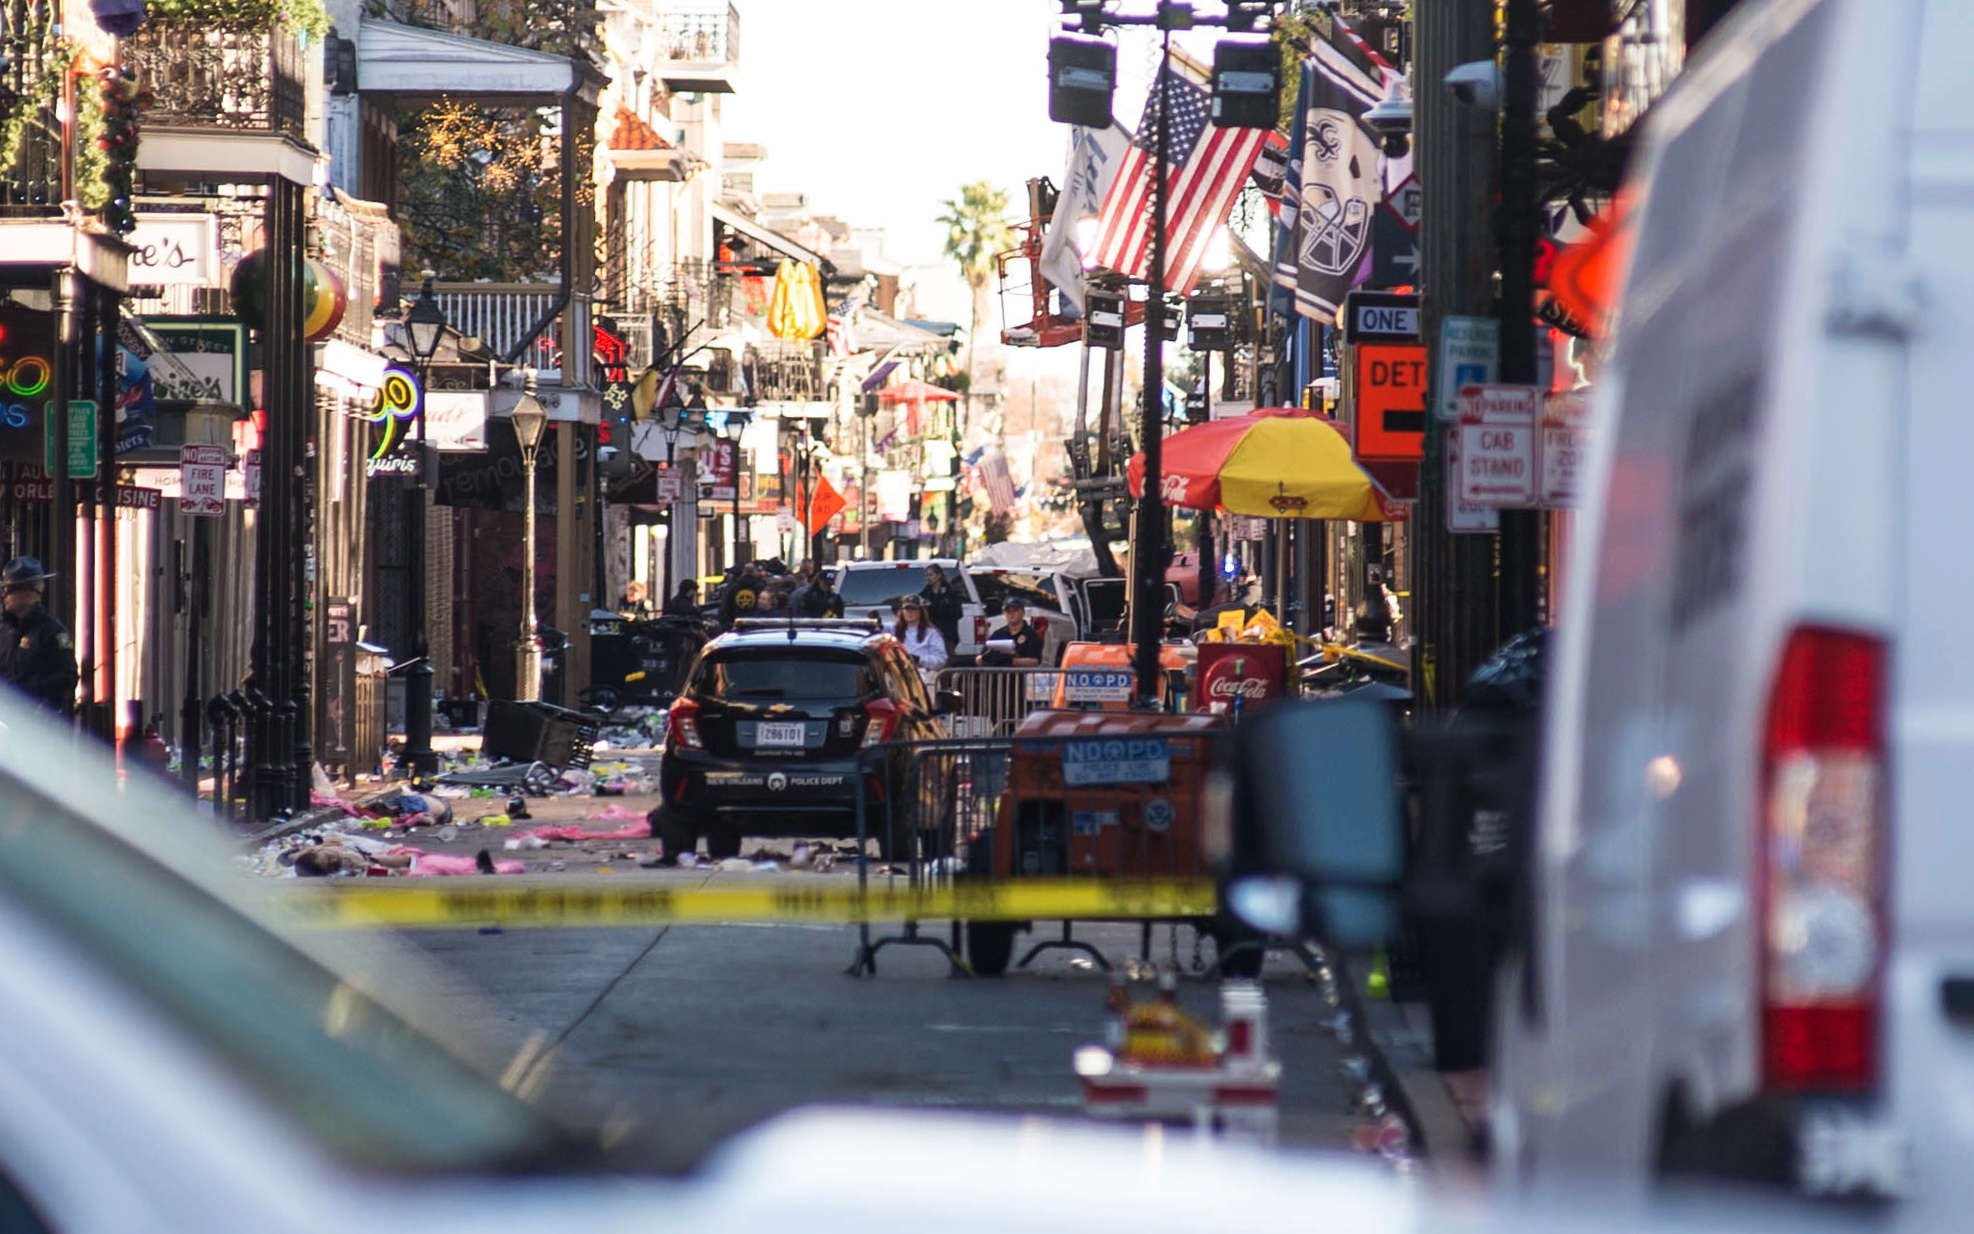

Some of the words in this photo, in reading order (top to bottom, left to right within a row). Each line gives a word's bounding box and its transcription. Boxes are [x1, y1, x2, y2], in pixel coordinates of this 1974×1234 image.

[1363, 309, 1407, 331] ONE
[1481, 431, 1514, 451] CAB
[183, 448, 198, 461] NO
[191, 468, 215, 480] FIRE
[1470, 458, 1525, 477] STAND
[189, 483, 215, 495] LANE
[706, 776, 725, 786] NEW
[727, 776, 763, 786] ORLEANS
[791, 776, 819, 785] POLICE
[821, 776, 844, 785] DEPT
